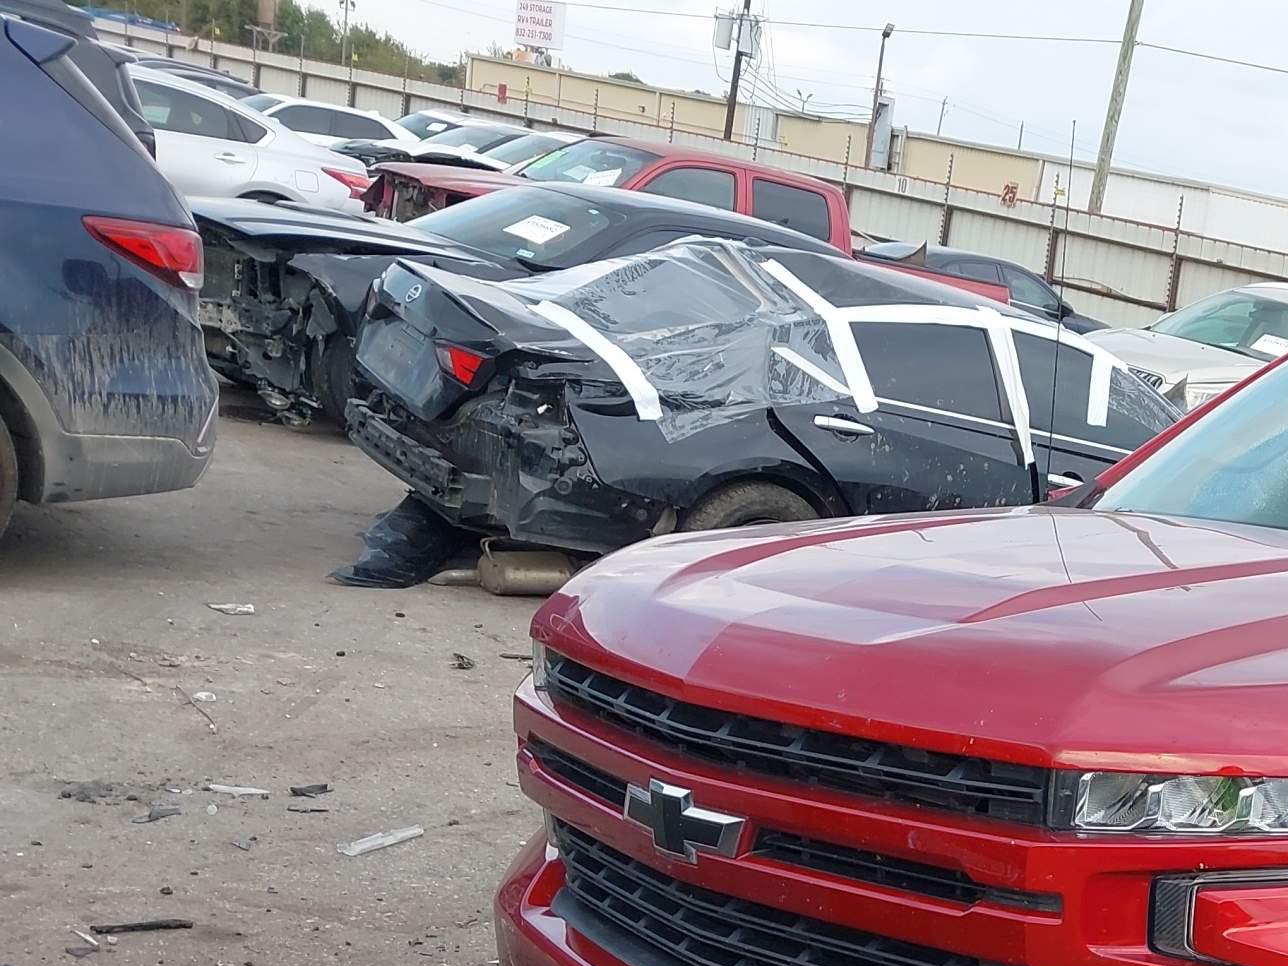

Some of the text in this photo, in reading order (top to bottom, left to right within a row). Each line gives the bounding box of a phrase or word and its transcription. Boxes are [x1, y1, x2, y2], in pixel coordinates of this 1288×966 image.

[530, 3, 552, 14] STORAGE
[530, 16, 552, 28] TRAILER
[897, 178, 907, 193] 10
[1001, 184, 1017, 203] 25
